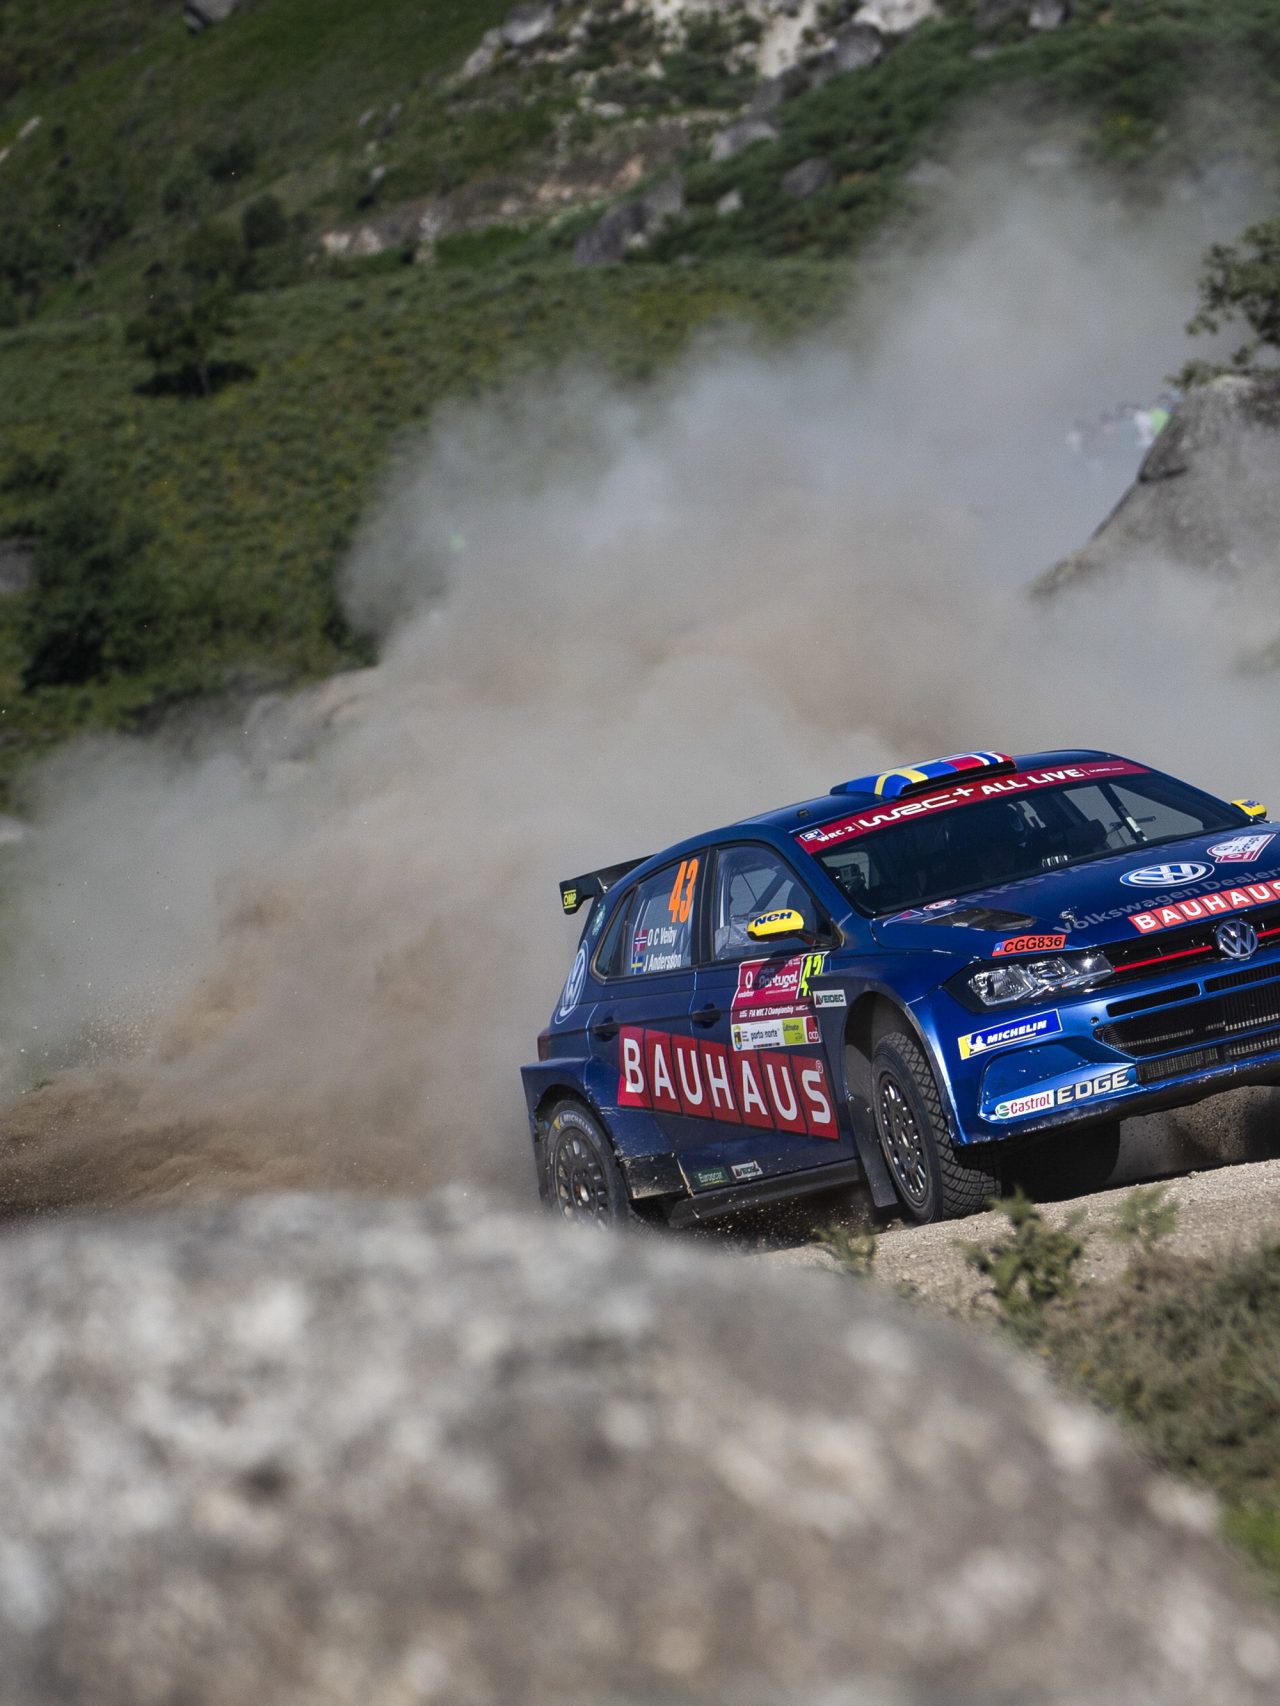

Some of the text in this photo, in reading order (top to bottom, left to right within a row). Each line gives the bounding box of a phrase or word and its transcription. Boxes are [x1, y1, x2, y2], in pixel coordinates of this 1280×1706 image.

[980, 780, 1028, 795] ALL
[1027, 768, 1085, 784] LIVE
[817, 825, 855, 842] WRC 2
[563, 892, 577, 906] OMP
[668, 858, 699, 923] 43
[1053, 886, 1200, 934] Volkswagen
[647, 928, 654, 947] O
[653, 928, 660, 945] C
[1003, 936, 1063, 953] CGG836
[643, 952, 682, 973] J Andersson
[759, 970, 798, 989] Portugal
[750, 1030, 764, 1042] porto
[765, 1029, 778, 1039] norte
[986, 1019, 1048, 1044] MICHELIN
[623, 1038, 832, 1124] BAUHAUS
[1010, 1069, 1130, 1115] Castrol EDGE
